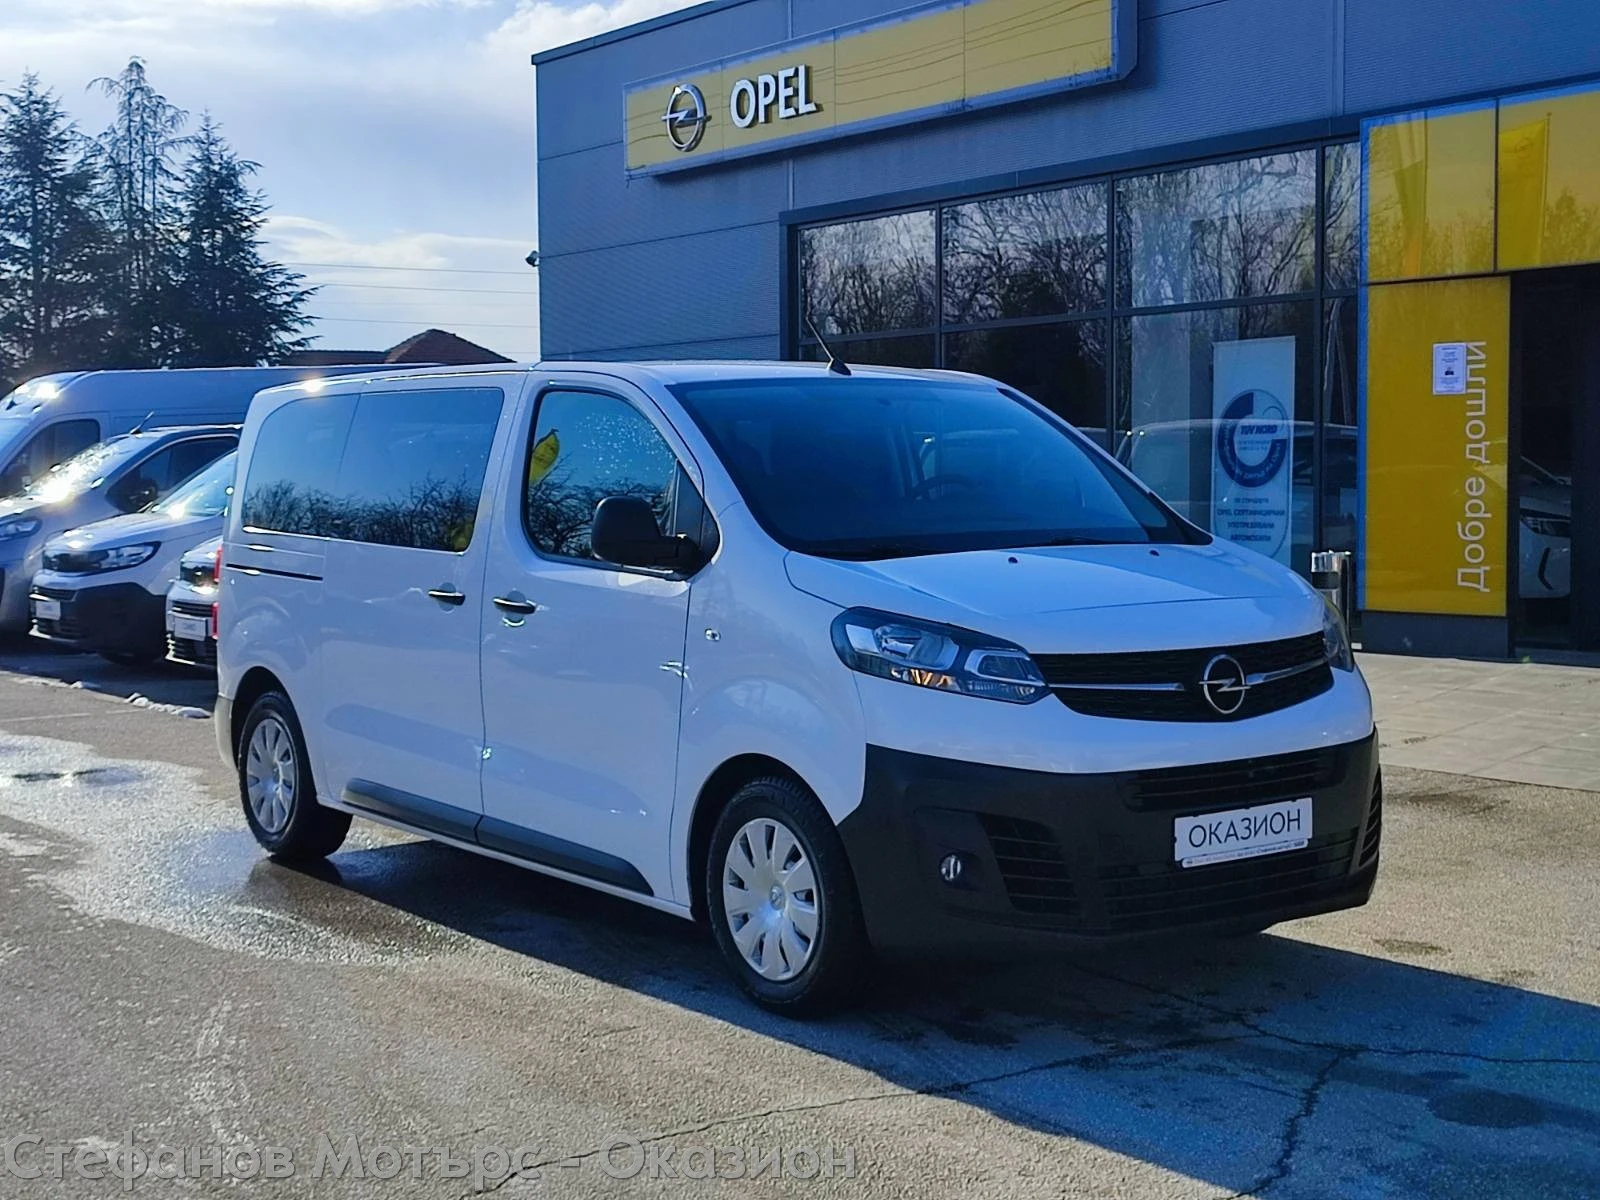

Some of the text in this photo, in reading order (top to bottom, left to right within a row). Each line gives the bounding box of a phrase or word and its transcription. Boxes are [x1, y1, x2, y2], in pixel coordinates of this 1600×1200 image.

[730, 64, 816, 128] OPEL
[1457, 341, 1492, 592] Добре дошли
[1189, 809, 1301, 848] ОКАЗИОН
